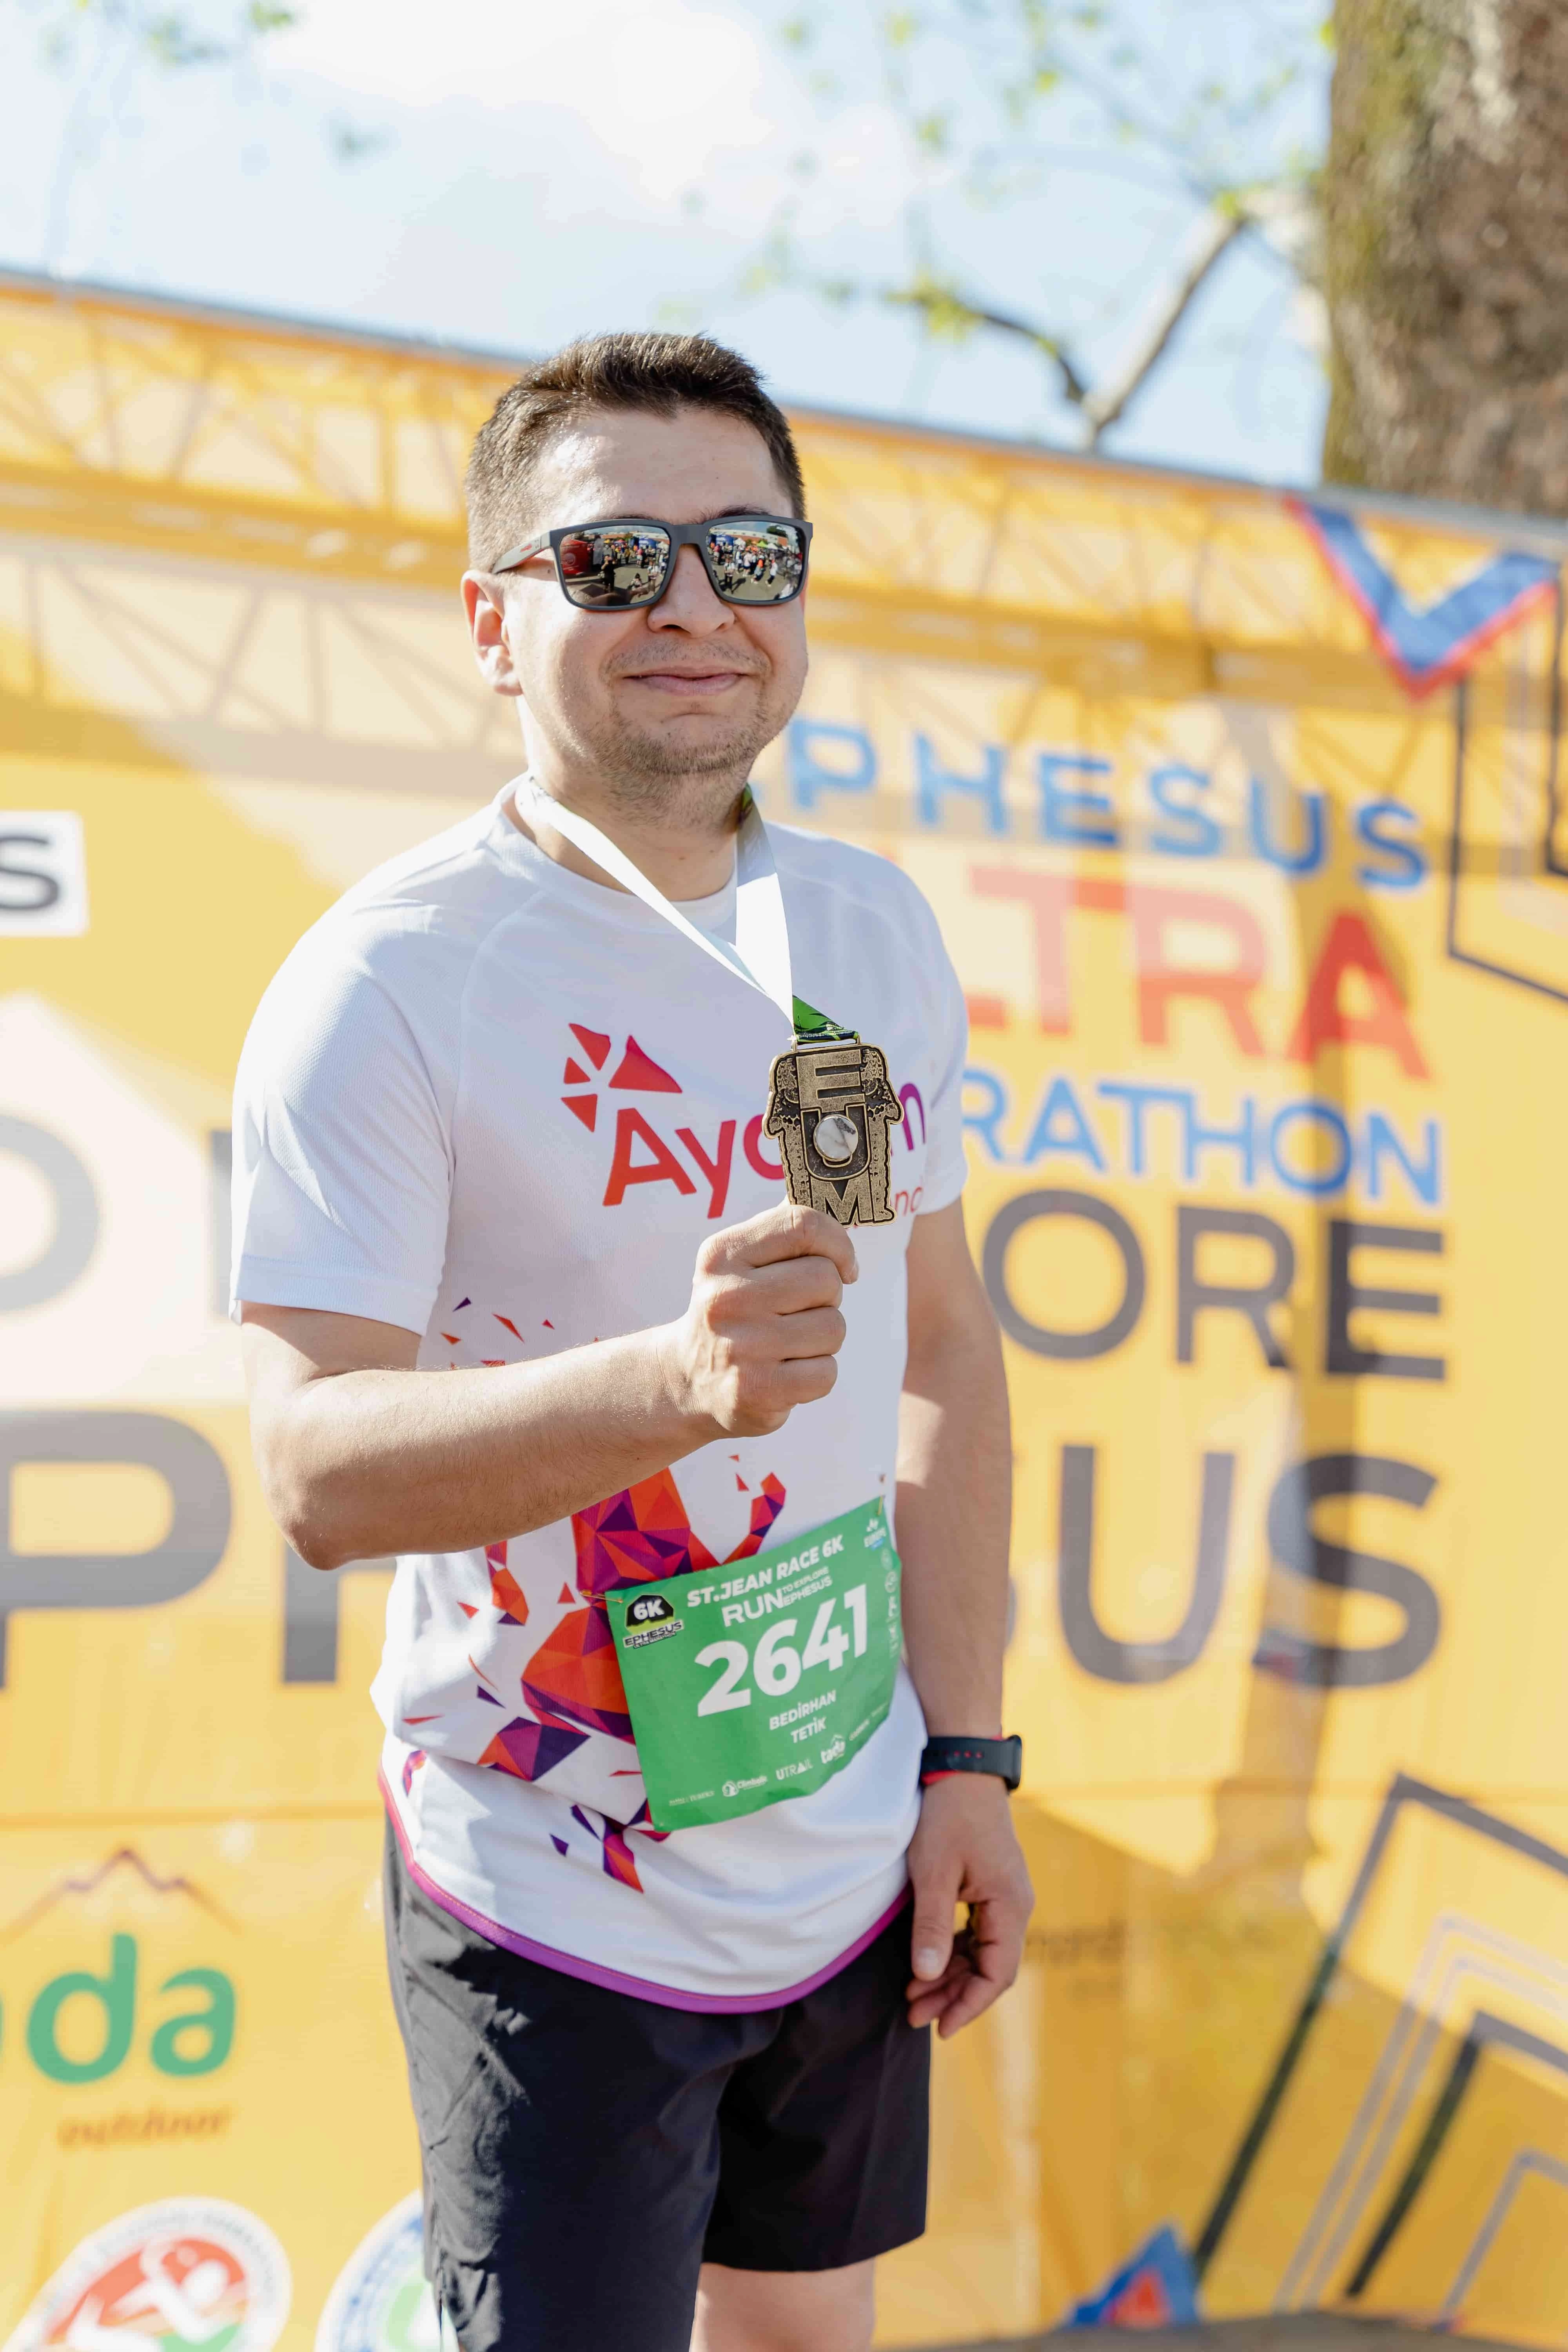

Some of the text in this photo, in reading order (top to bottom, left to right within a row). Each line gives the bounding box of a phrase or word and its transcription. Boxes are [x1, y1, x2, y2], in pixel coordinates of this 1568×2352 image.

[747, 718, 1429, 889] PHESUS
[965, 864, 1432, 1083] TRA
[687, 1534, 844, 1607] ST.JEAN RACE 6K
[782, 1566, 829, 1594] TO EXPLORE
[784, 1575, 833, 1606] EPHESUS
[633, 1599, 665, 1620] 6K
[721, 1588, 784, 1628] RUN
[625, 1621, 682, 1646] EPHESUS
[694, 1584, 867, 1717] 2641
[769, 1690, 837, 1731] BEDİRHAN
[790, 1716, 827, 1744] TETİK
[0, 1932, 236, 2085] da
